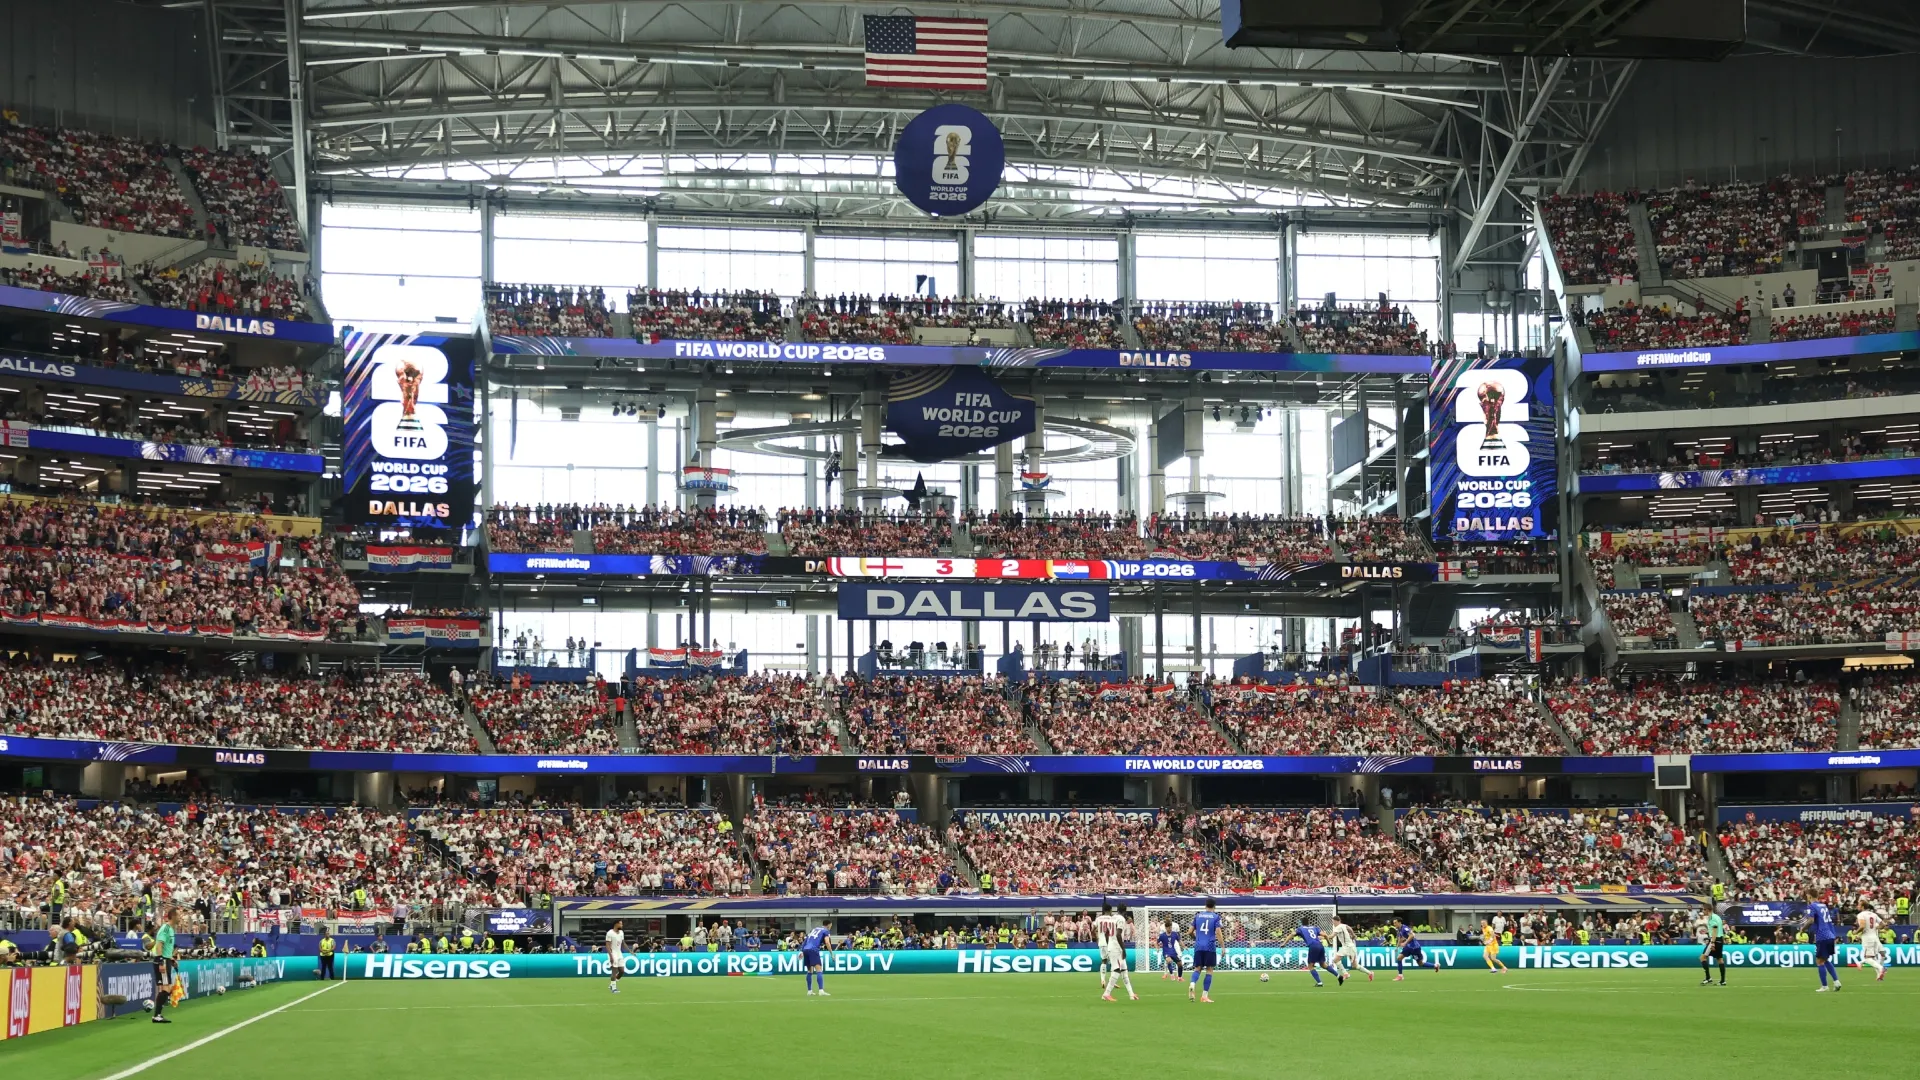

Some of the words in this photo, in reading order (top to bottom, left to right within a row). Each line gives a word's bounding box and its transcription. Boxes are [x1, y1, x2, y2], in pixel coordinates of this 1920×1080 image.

[942, 172, 959, 180] FIFA
[929, 192, 967, 201] 2026
[930, 185, 954, 193] WORLD
[196, 314, 275, 336] DALLAS
[675, 342, 714, 357] FIFA
[716, 343, 781, 358] WORLD
[784, 344, 820, 359] CUP
[822, 346, 885, 360] 2026
[1637, 351, 1712, 365] #FIFAWorldCup
[1119, 352, 1192, 367] DALLAS
[955, 392, 992, 408] FIFA
[922, 407, 985, 423] WORLD
[988, 410, 1022, 424] CUP
[938, 425, 999, 438] 2026
[394, 436, 427, 448] FIFA
[371, 461, 419, 474] WORLD
[421, 462, 448, 475] CUP
[1478, 455, 1510, 466] FIFA
[370, 474, 448, 494] 2026
[1457, 480, 1505, 491] WORLD
[1505, 480, 1532, 491] CUP
[1457, 492, 1532, 509] 2026
[369, 500, 450, 518] DALLAS
[1456, 516, 1534, 531] DALLAS
[526, 557, 590, 570] #FIFAWorldCup
[936, 559, 954, 575] 3
[1002, 560, 1019, 576] 2
[1143, 564, 1195, 577] 2026
[1342, 566, 1403, 578] DALLAS
[866, 589, 1097, 618] DALLAS
[215, 752, 265, 764] DALLAS
[858, 759, 909, 770] DALLAS
[1125, 759, 1151, 770] FIFA
[1152, 759, 1195, 770] WORLD
[1197, 759, 1221, 770] CUP
[1222, 759, 1264, 770] 2026
[1473, 760, 1522, 770] DALLAS
[1800, 810, 1873, 821] #FIFAWorldCup
[1200, 919, 1209, 934] 4
[1307, 928, 1317, 939] 8
[957, 950, 1093, 973] Hisense
[1270, 949, 1294, 967] of
[1431, 948, 1458, 967] TV
[1518, 946, 1649, 969] Hisense
[1748, 945, 1816, 967] Origin
[364, 954, 511, 979] Hisense
[624, 953, 692, 977] Origin
[697, 953, 720, 975] of
[728, 953, 773, 973] RGB
[866, 952, 894, 971] TV
